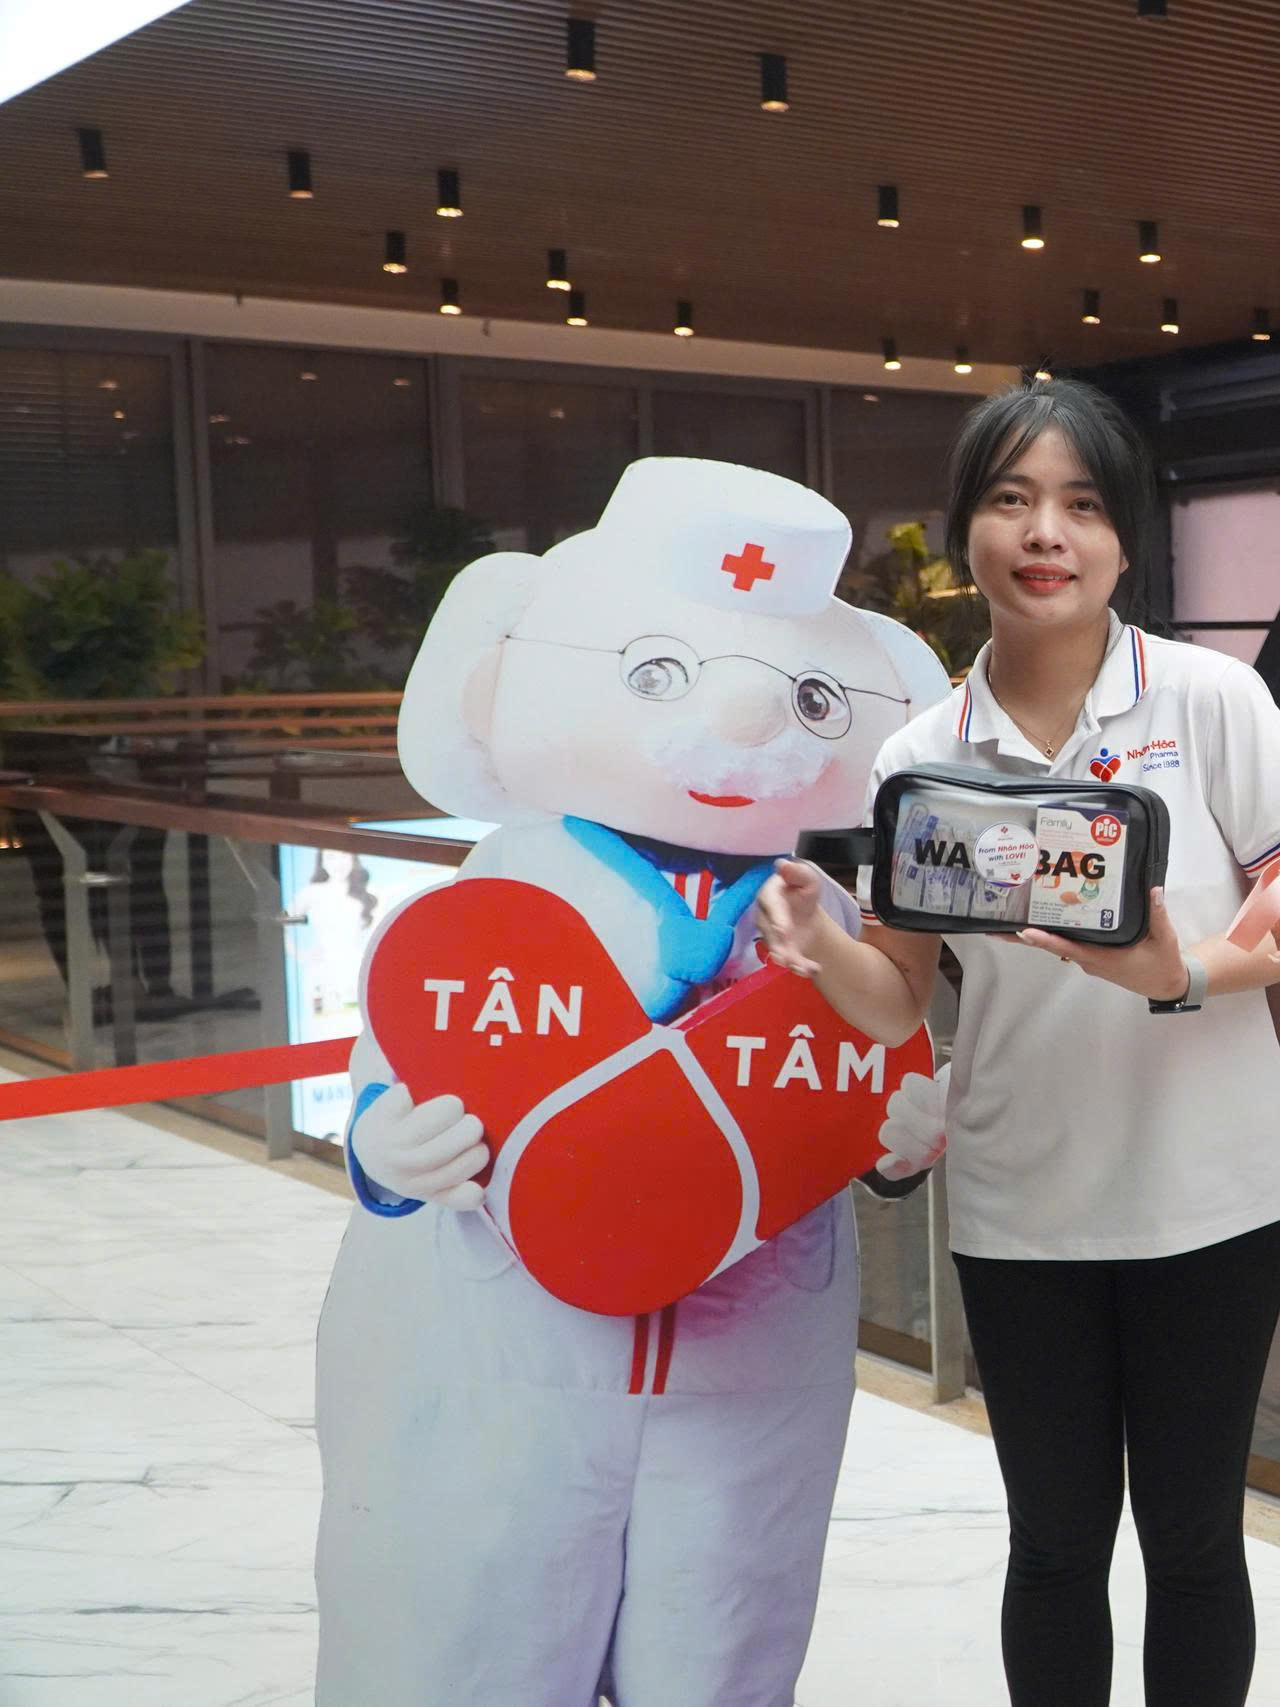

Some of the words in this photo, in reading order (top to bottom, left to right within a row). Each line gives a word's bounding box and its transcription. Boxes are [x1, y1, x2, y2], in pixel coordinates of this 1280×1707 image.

[1150, 751, 1179, 759] Pharma
[1143, 763, 1162, 772] Since
[1163, 760, 1180, 769] 1988
[1040, 816, 1072, 830] Family
[915, 838, 1106, 880] WABAG
[1103, 910, 1112, 919] 20
[424, 967, 583, 1047] TẬN
[726, 1024, 887, 1094] TÂM
